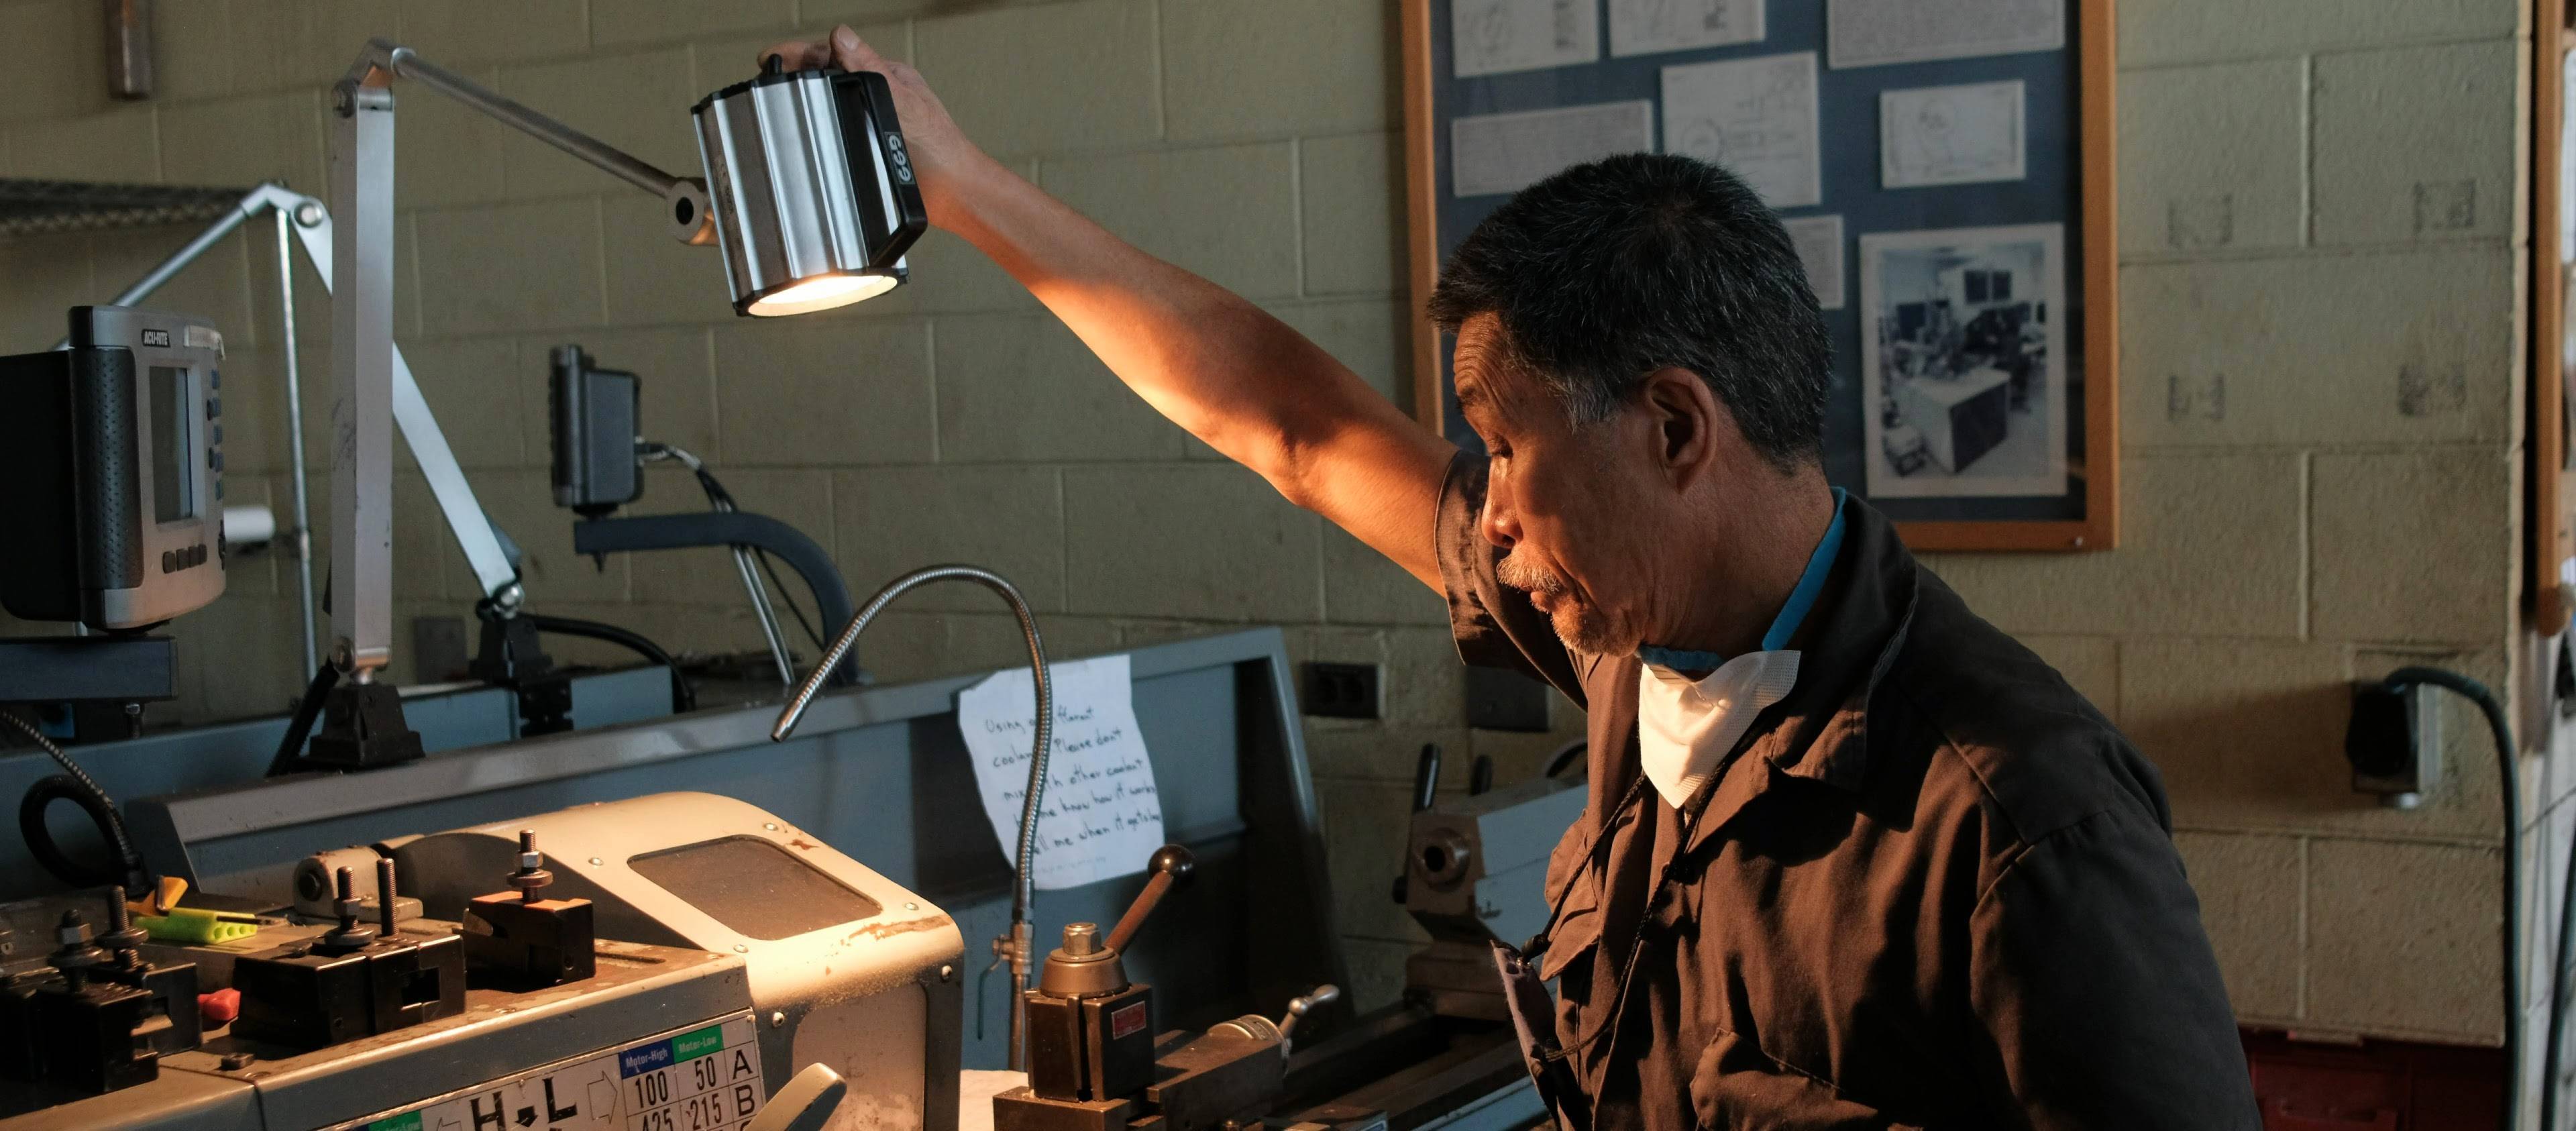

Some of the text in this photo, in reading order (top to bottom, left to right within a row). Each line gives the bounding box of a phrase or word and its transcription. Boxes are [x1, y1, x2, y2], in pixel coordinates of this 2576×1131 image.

[144, 331, 168, 345] ACU-RITE
[985, 718, 1026, 735] Using
[993, 744, 1034, 767] coolan
[1054, 737, 1093, 753] Please
[1070, 764, 1101, 784] other
[1059, 796, 1090, 812] know
[1091, 790, 1112, 804] how
[1116, 782, 1124, 800] it
[1034, 833, 1049, 854] ell
[1054, 838, 1073, 848] me
[1079, 821, 1110, 840] when
[1116, 812, 1124, 830] it
[626, 1036, 717, 1068] Motor-High Motor-Low
[635, 1049, 753, 1108] 100 50 A
[470, 1076, 578, 1131] H L
[642, 1084, 755, 1131] 425 215 B
